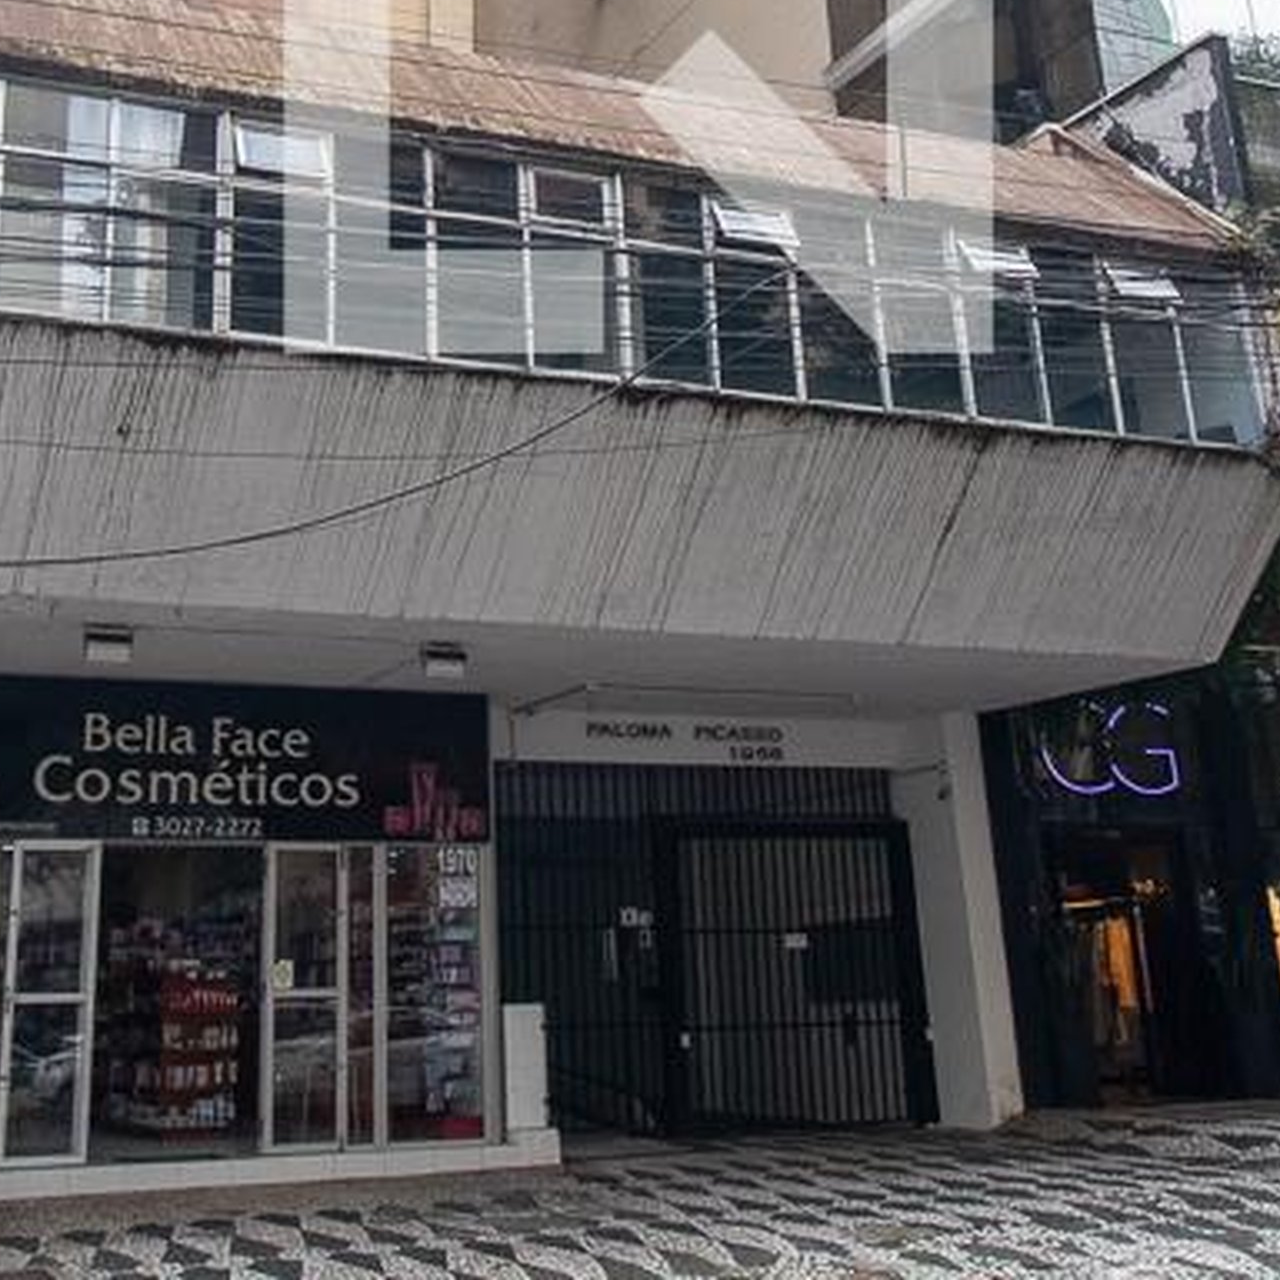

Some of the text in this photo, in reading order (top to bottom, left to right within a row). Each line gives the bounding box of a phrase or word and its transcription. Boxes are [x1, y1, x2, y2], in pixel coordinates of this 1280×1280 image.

[82, 712, 312, 758] Bella Face
[586, 722, 784, 742] PALOMA PICASSO
[33, 754, 361, 807] Cosméticos
[154, 817, 263, 837] 3027-2272
[437, 847, 477, 874] 1970
